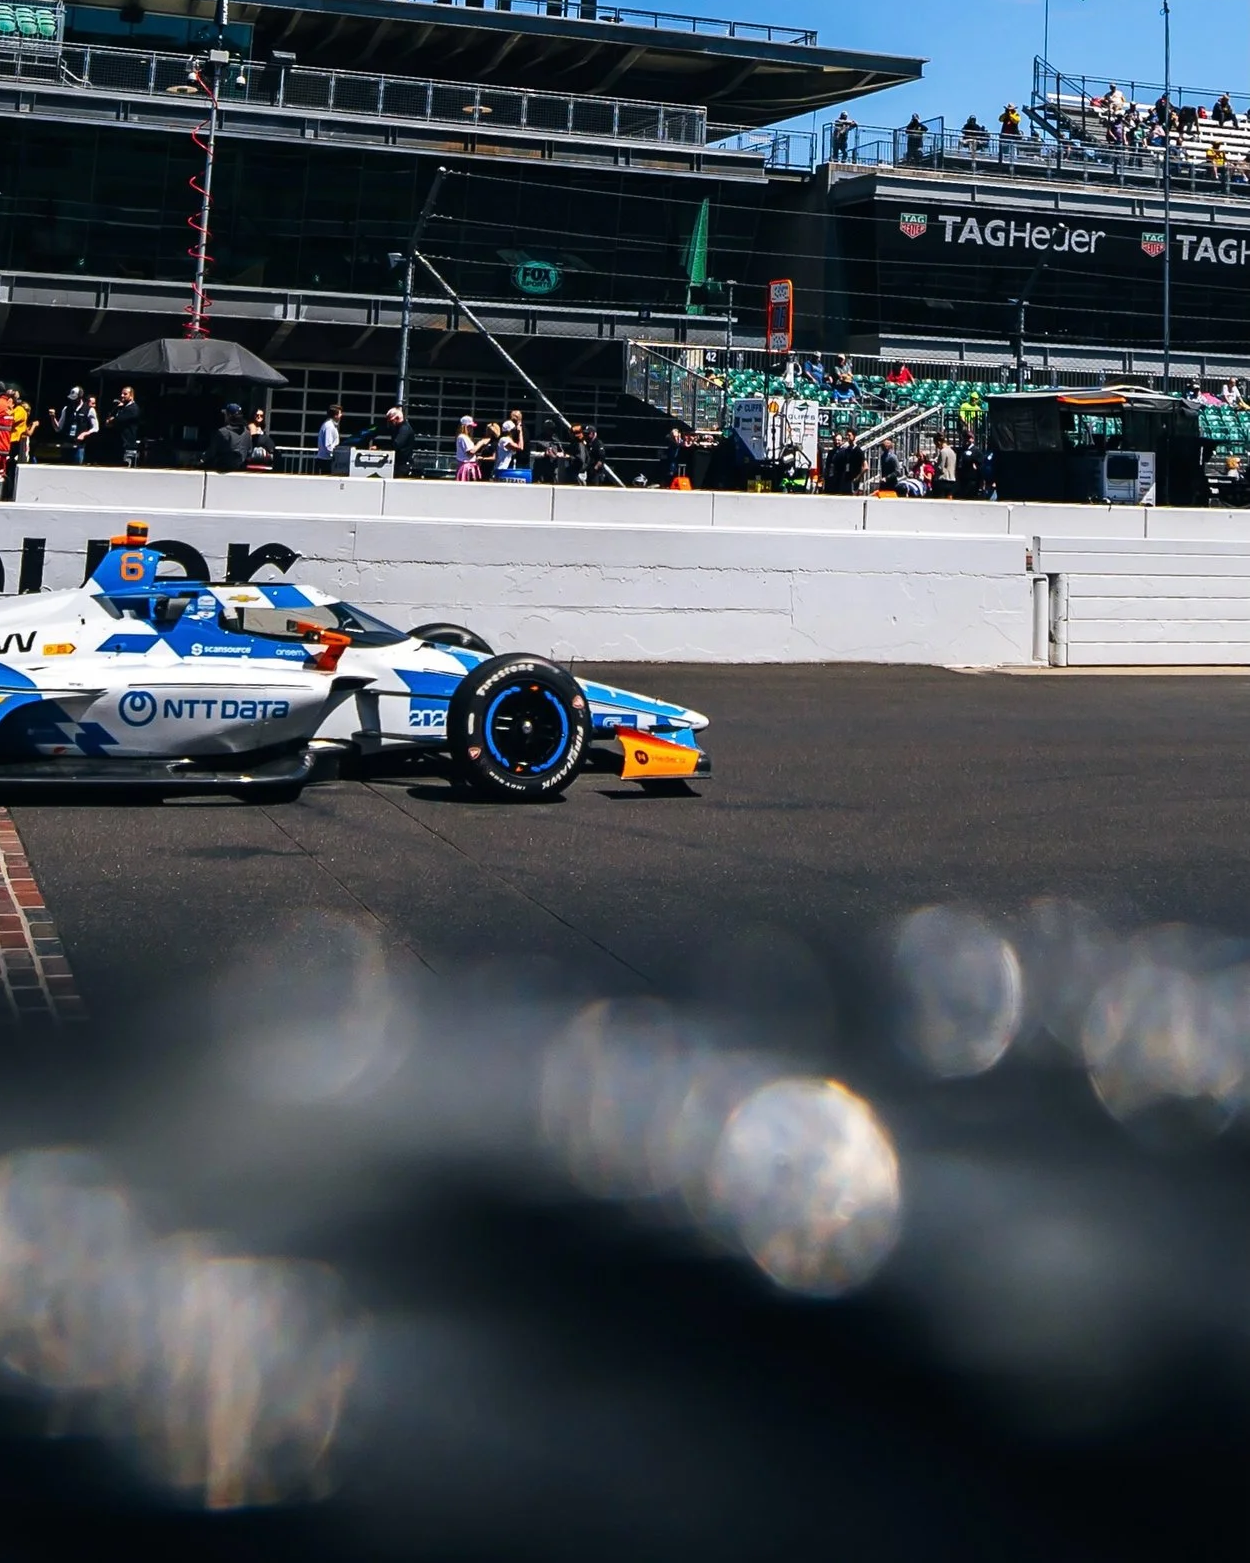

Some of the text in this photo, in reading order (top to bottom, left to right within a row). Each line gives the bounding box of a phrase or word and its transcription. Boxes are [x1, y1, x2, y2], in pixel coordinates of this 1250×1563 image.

[903, 214, 925, 223] TAG
[1145, 234, 1164, 242] TAG
[522, 266, 552, 282] FOX
[706, 352, 717, 362] 42
[120, 552, 145, 581] 6
[476, 664, 535, 697] Firestone
[542, 725, 584, 790] FIREHAWK
